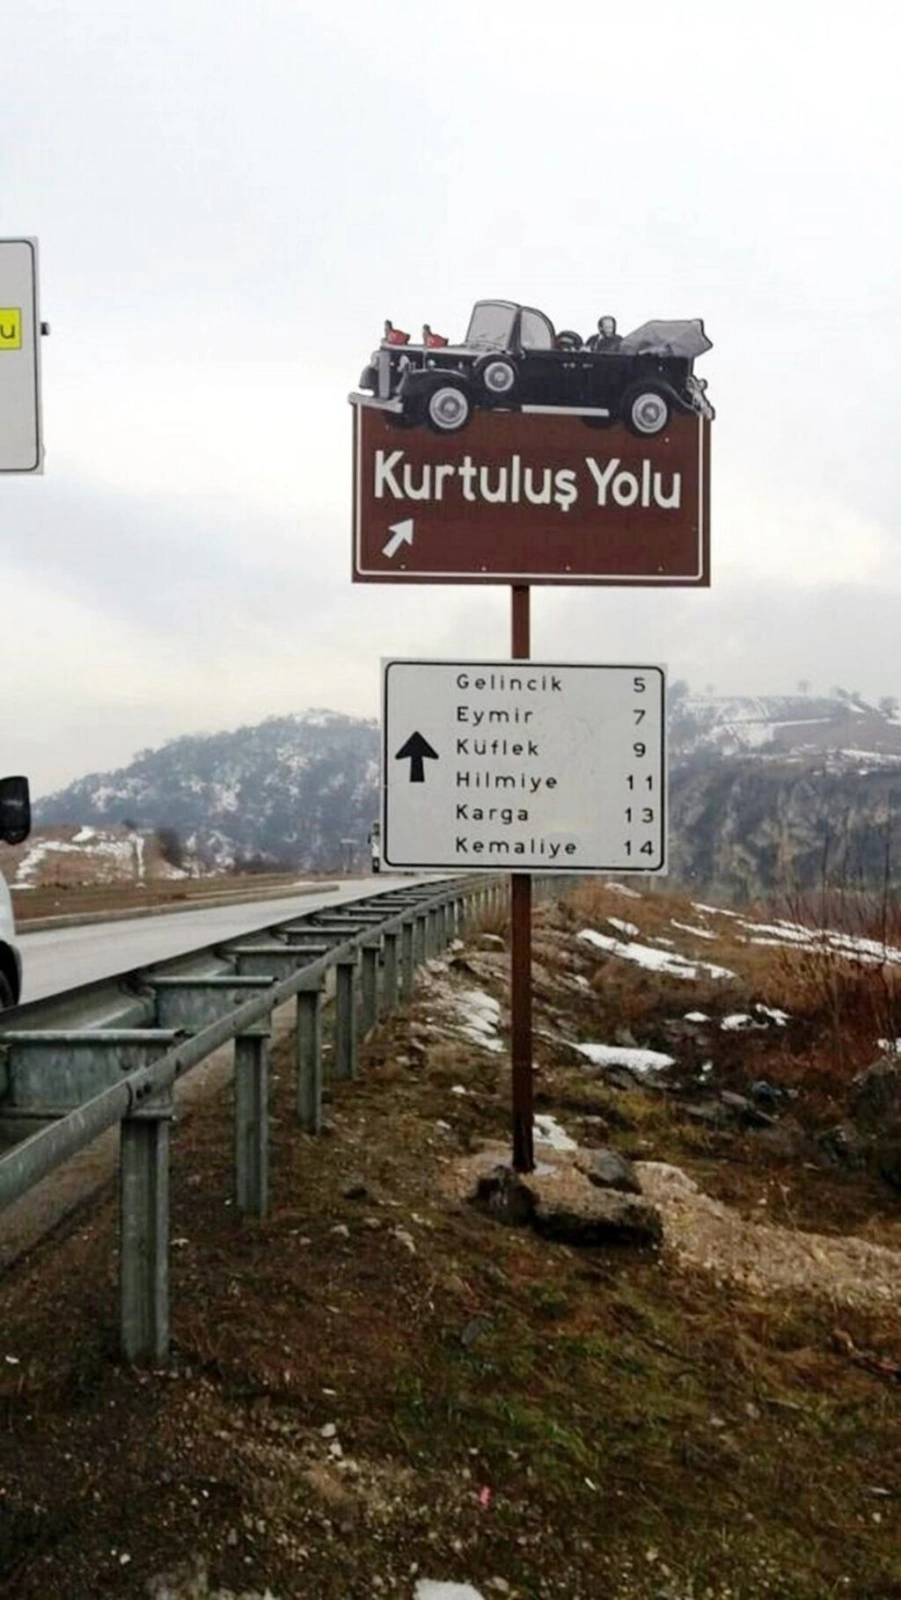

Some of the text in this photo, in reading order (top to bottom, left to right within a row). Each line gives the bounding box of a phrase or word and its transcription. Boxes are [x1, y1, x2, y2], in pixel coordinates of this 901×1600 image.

[374, 449, 681, 512] Kurtuluş Yolu
[456, 673, 646, 693] Gelincik 5
[456, 706, 646, 727] Eymir 7
[456, 738, 646, 758] Küflek 9
[456, 771, 653, 793] Hilmiye 11
[456, 804, 654, 825] Karga 13
[456, 837, 654, 859] Kemaliye 14
